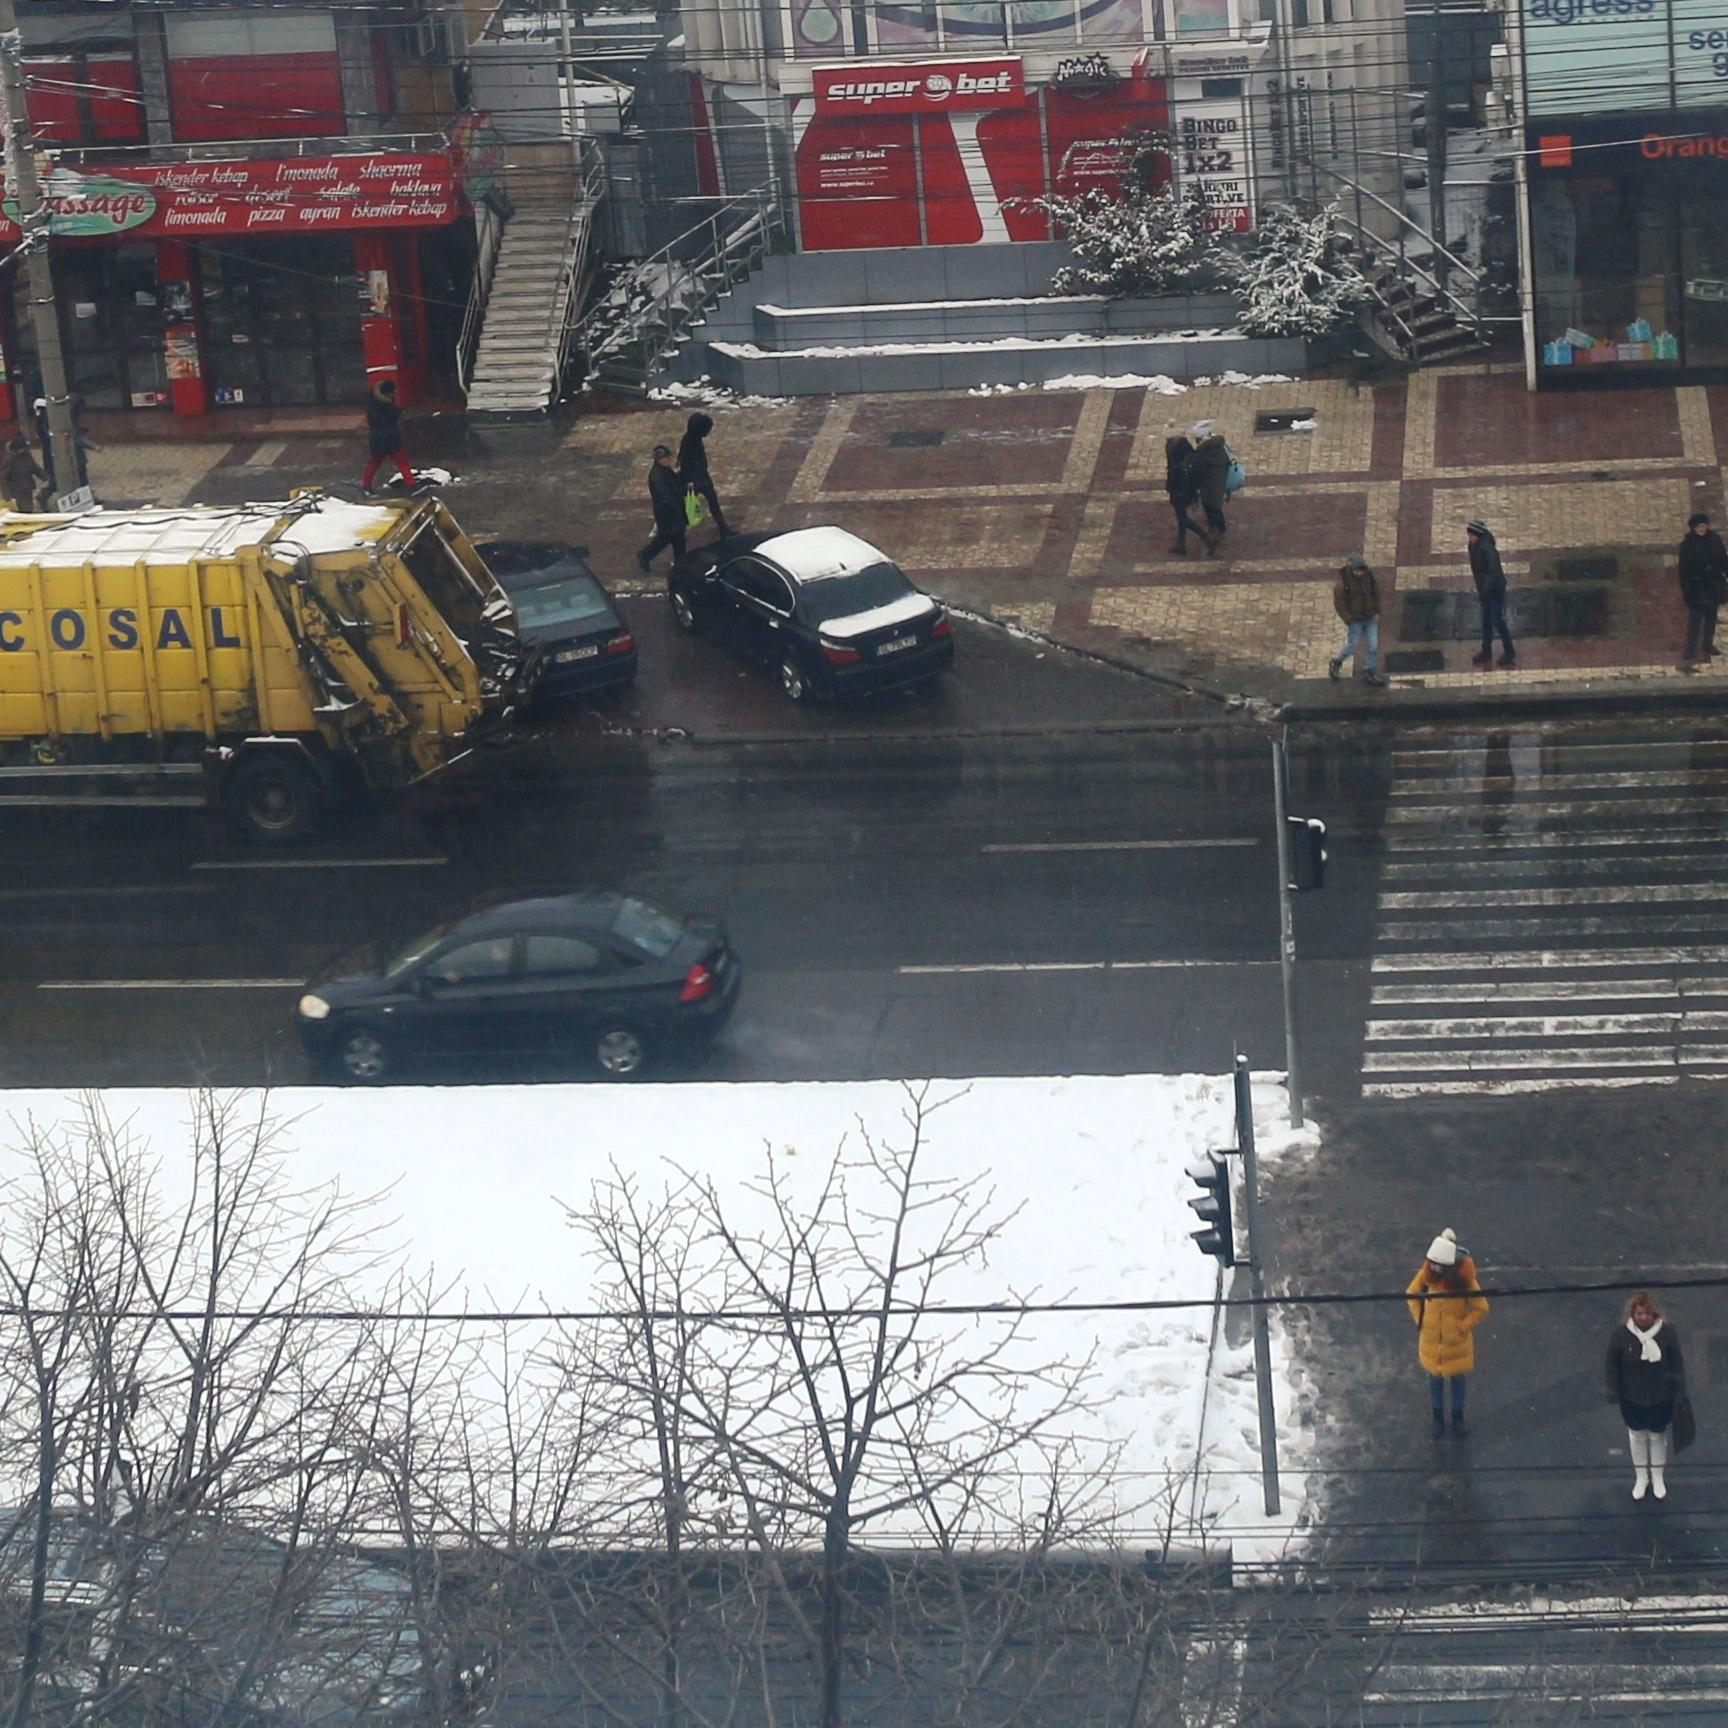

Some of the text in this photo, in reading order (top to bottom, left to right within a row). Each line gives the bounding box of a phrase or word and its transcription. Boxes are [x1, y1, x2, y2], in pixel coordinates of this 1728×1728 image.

[827, 72, 1012, 104] super bet
[1181, 117, 1236, 134] BINGO
[1183, 135, 1219, 150] BET
[359, 160, 422, 179] shaorma
[40, 193, 145, 224] assage
[165, 206, 226, 226] limonada
[246, 206, 285, 226] pizza
[299, 204, 341, 223] ayran
[408, 199, 447, 218] kebap
